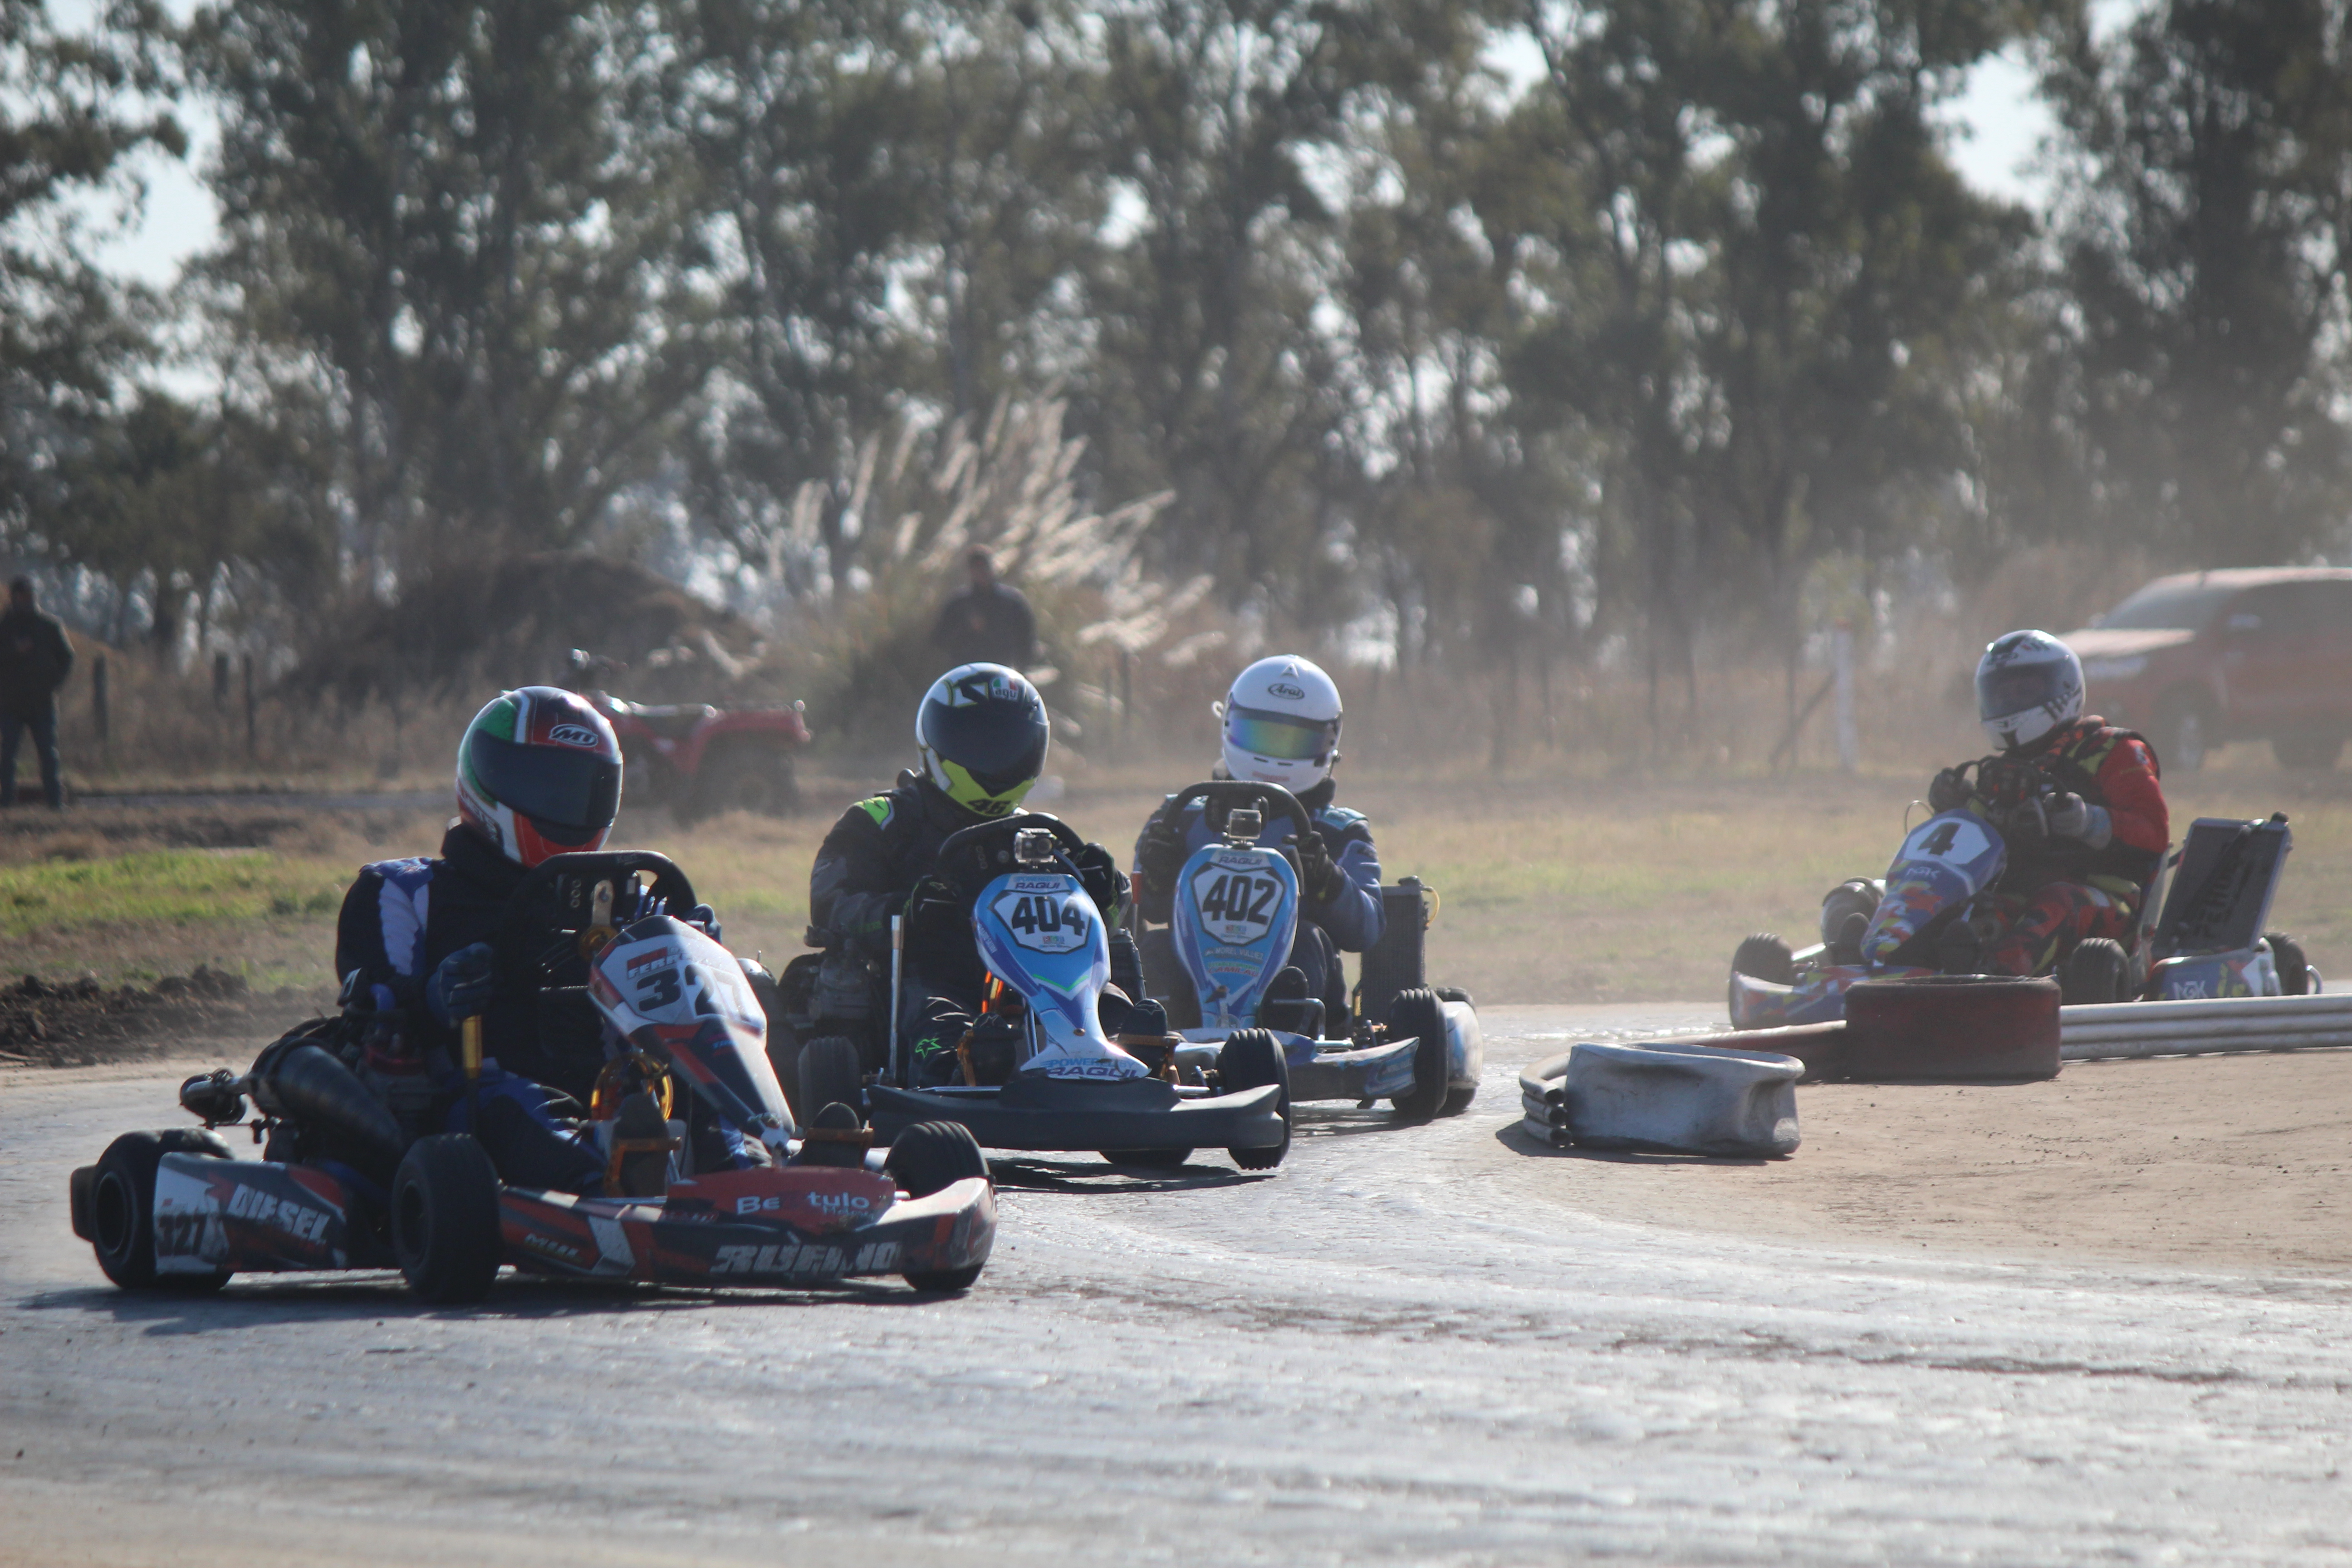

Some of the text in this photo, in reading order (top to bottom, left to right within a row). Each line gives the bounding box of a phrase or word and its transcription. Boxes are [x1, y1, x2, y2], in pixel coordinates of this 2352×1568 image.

[968, 798, 1011, 814] 46
[1917, 822, 1962, 855] 4
[1011, 896, 1086, 936] 404
[1202, 874, 1277, 925] 402
[1045, 1066, 1138, 1078] RAQUI
[227, 1183, 331, 1245] DIESEL
